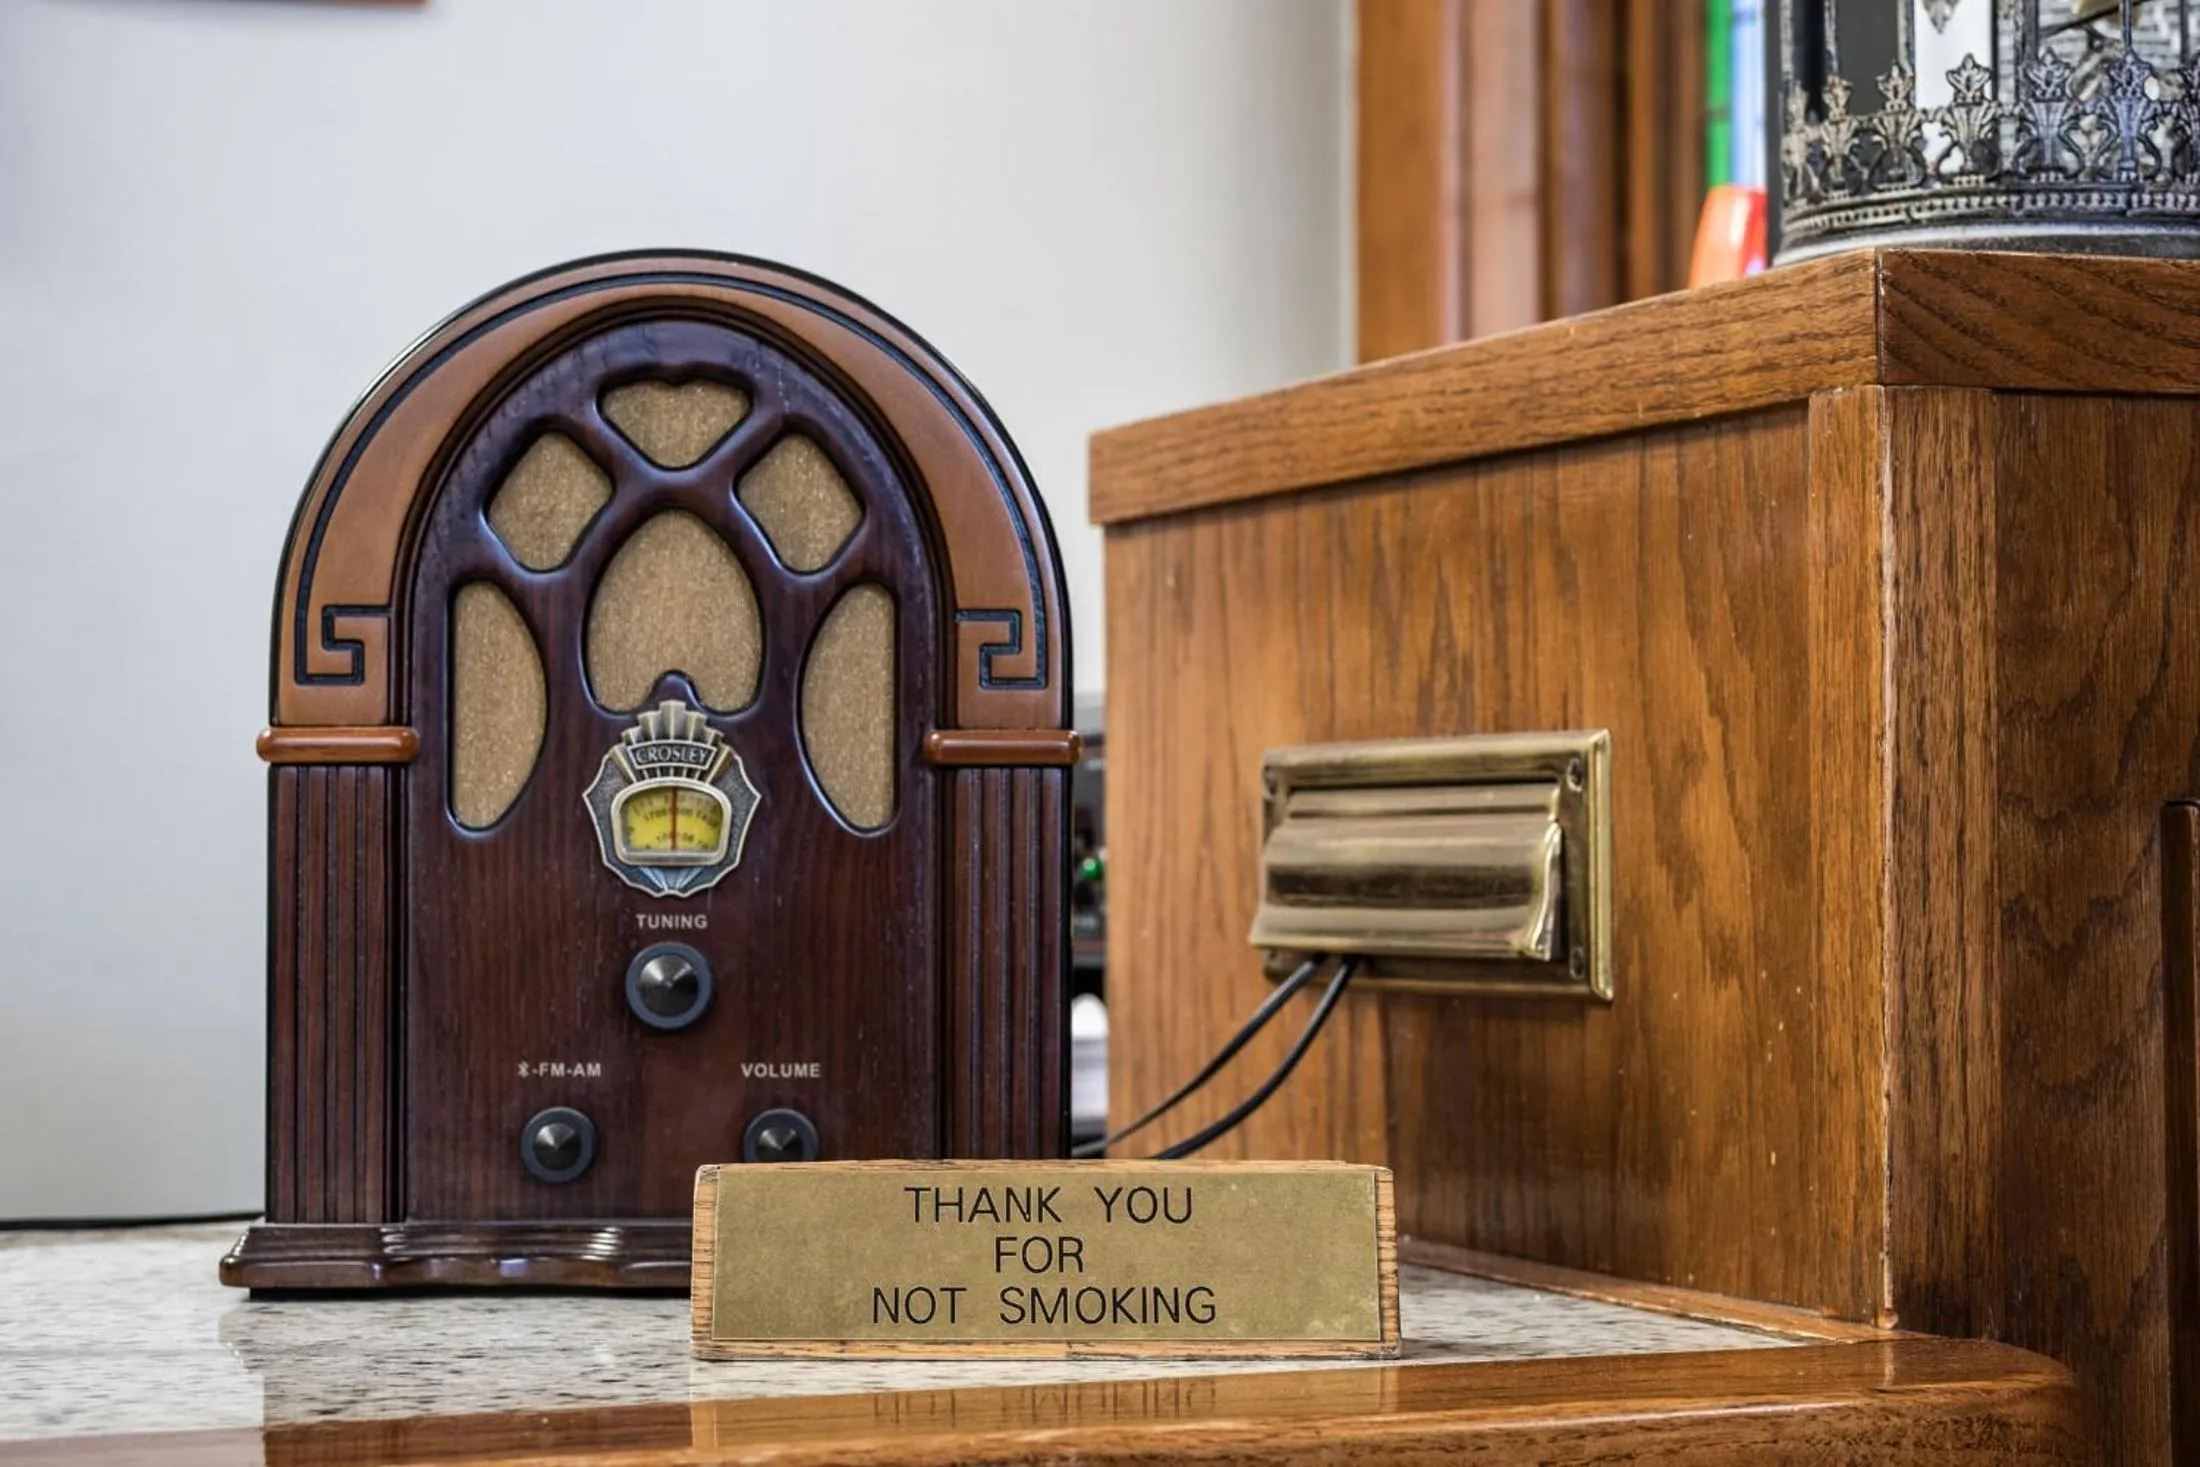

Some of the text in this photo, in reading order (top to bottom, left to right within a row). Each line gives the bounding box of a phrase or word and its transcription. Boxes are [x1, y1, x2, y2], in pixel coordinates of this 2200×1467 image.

[635, 745, 709, 765] CROSLEY
[636, 914, 708, 930] TUNING
[740, 1062, 821, 1078] VOLUME
[904, 1186, 1193, 1224] THANK YOU
[995, 1236, 1085, 1274] FOR
[873, 1286, 1217, 1325] NOT SMOKING
